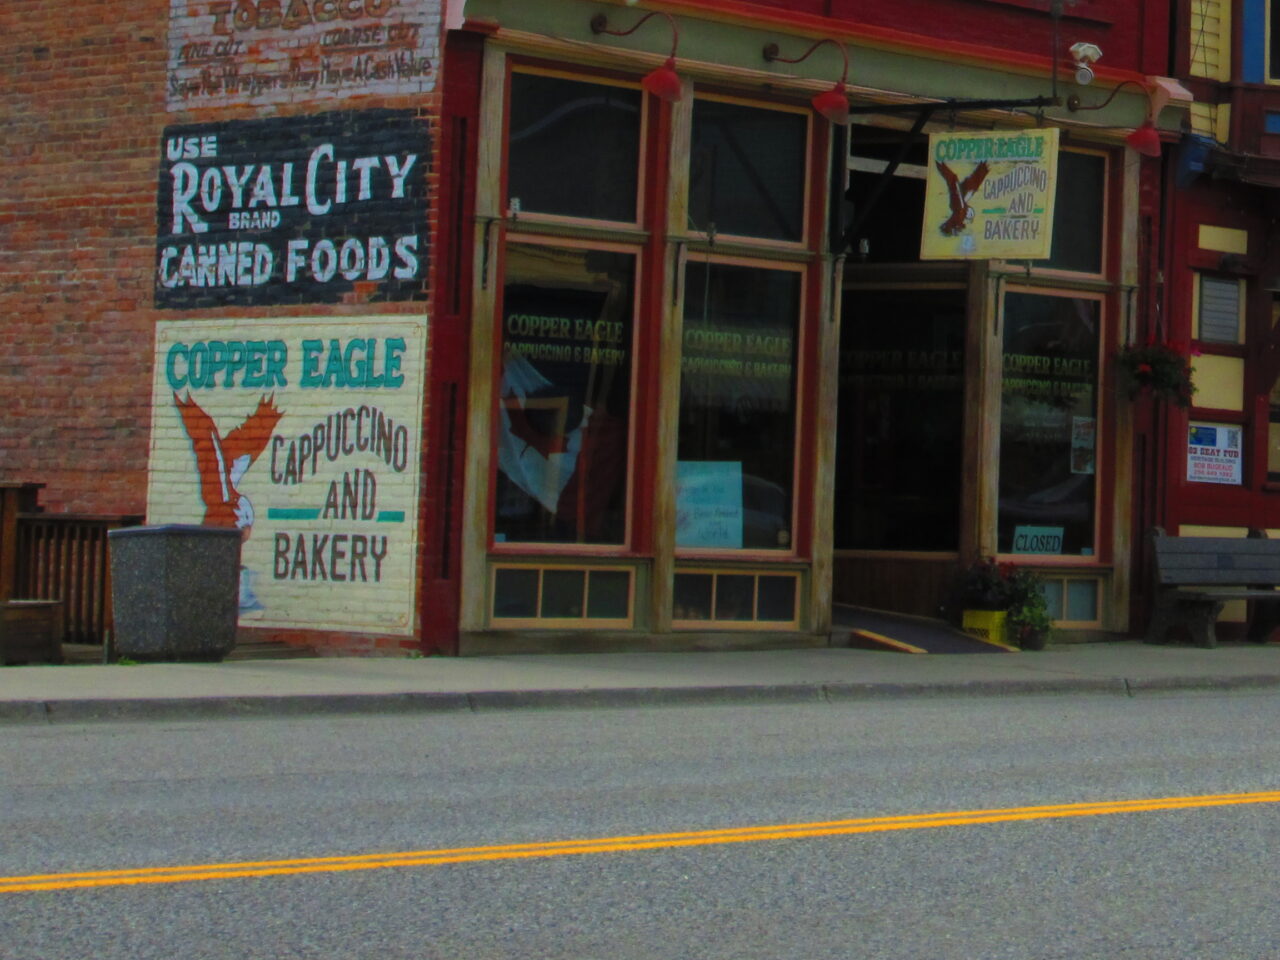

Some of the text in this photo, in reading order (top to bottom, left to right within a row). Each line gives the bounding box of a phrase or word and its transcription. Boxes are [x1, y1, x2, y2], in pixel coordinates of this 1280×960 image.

[213, 40, 244, 58] CUT
[167, 135, 217, 162] USE
[936, 134, 1045, 161] COPPER EAGLE
[169, 143, 418, 235] ROYAL CITY
[983, 162, 1048, 200] CAPPUCCINO
[1008, 192, 1034, 215] AND
[228, 210, 281, 230] BRAND
[984, 220, 1041, 241] BAKERY
[158, 235, 418, 289] CANNED FOODS
[507, 314, 624, 342] COPPER EAGLE
[166, 337, 407, 390] COPPER EAGLE
[504, 341, 572, 362] CAPPUCCINO
[582, 346, 626, 366] BAKERY
[270, 405, 409, 486] CAPPUCCINO
[322, 468, 377, 521] AND
[1015, 533, 1062, 553] CLOSED
[273, 533, 388, 583] BAKERY
